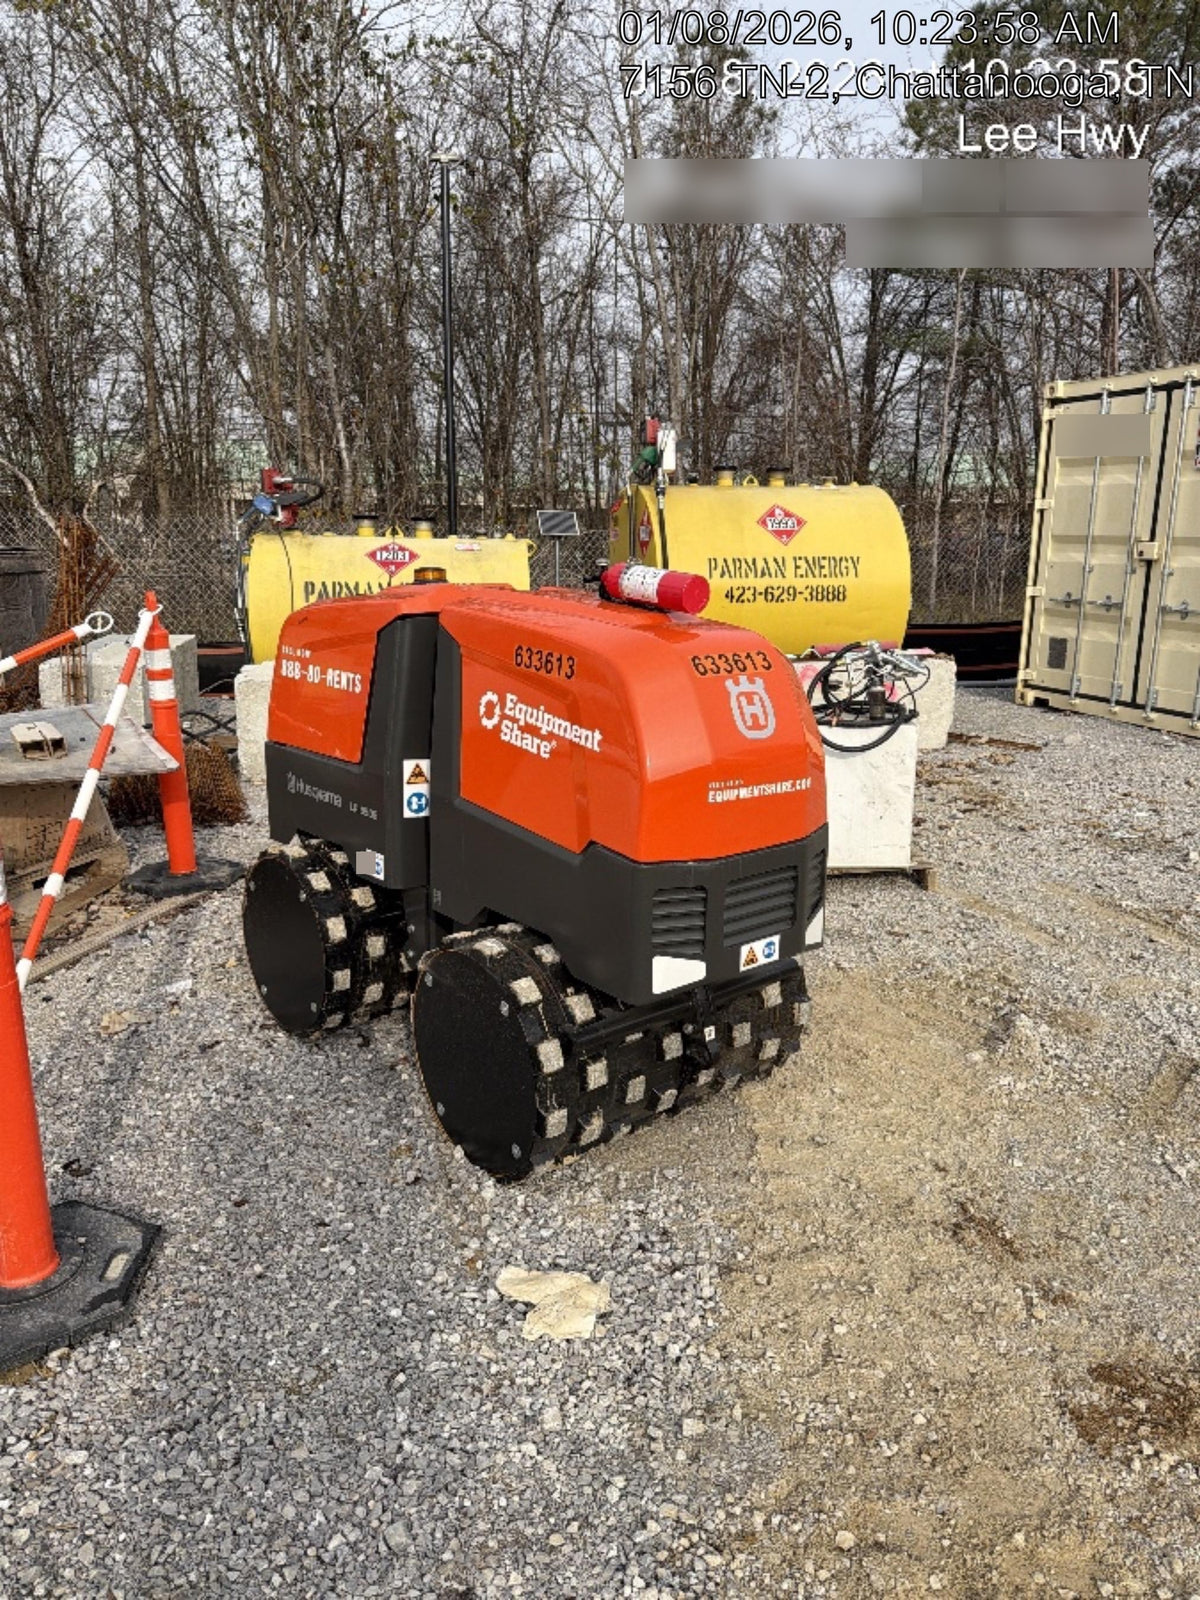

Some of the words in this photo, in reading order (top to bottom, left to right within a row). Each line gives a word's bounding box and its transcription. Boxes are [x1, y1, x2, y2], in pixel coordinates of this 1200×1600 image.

[708, 555, 786, 580] PARMAN
[794, 555, 861, 579] ENERGY
[724, 584, 847, 604] 423-629-3888
[281, 659, 362, 694] 888-80-RENTS
[514, 645, 575, 680] 633613
[691, 650, 773, 677] 633613
[504, 693, 602, 752] Equipment
